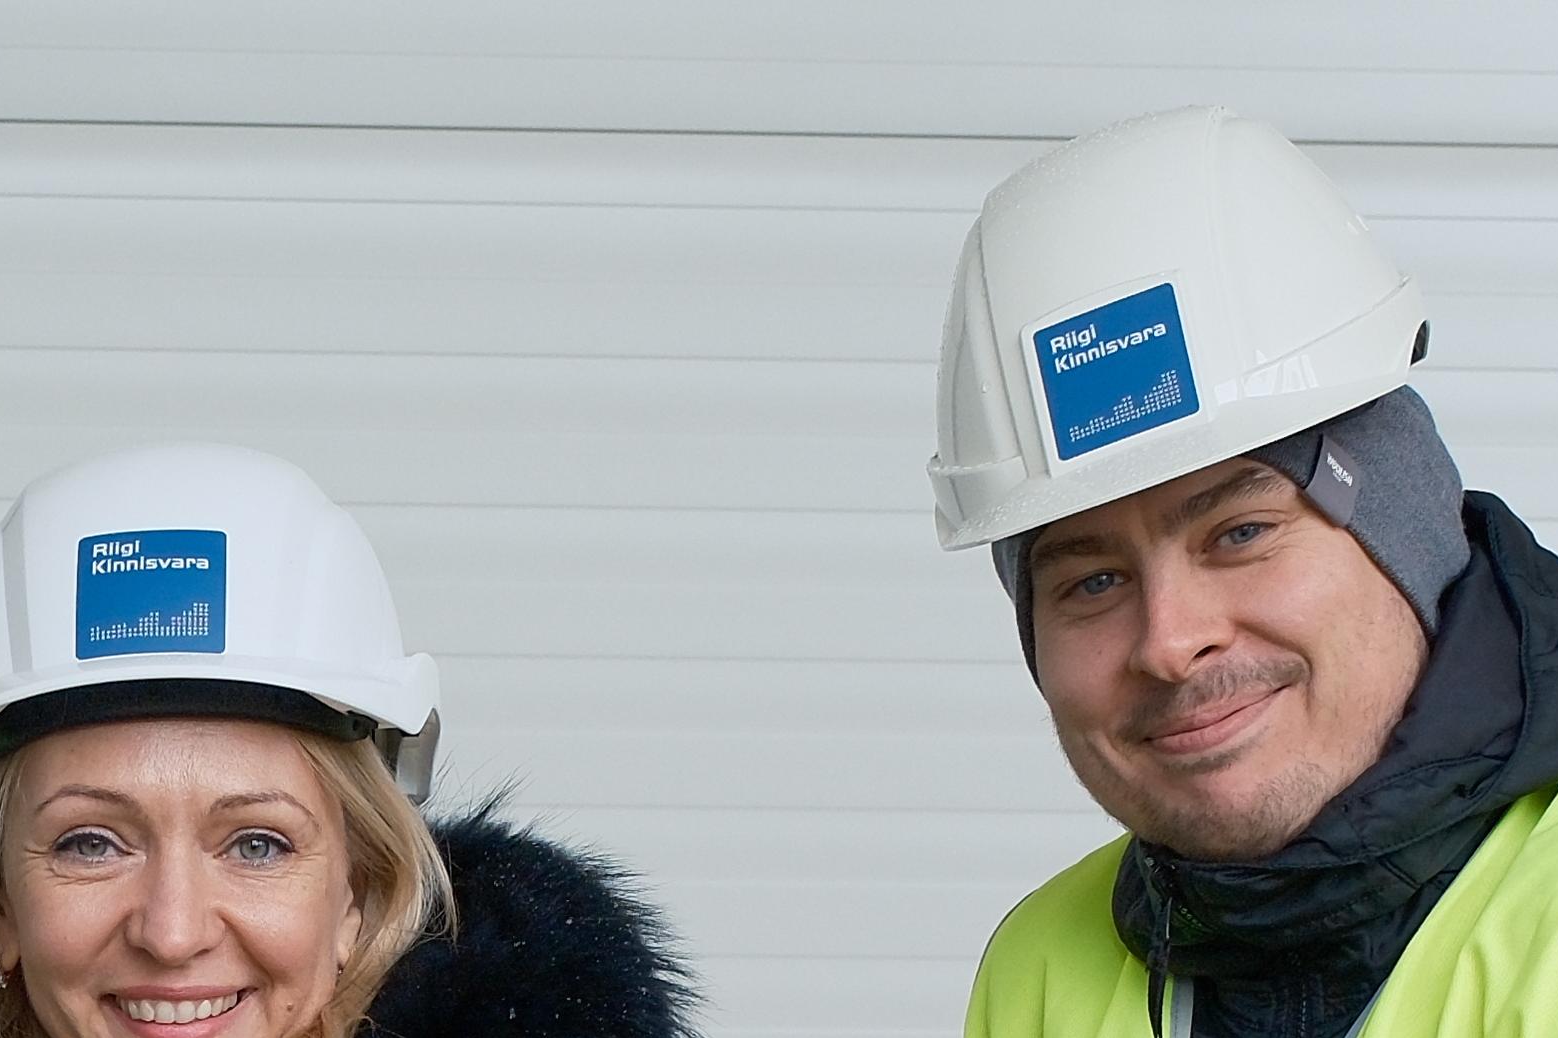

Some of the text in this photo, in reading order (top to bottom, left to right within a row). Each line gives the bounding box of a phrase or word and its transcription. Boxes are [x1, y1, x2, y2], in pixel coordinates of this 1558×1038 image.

[1049, 323, 1097, 355] Riigi
[1054, 322, 1167, 374] Kinnisvara
[92, 540, 141, 558] Riigi
[92, 556, 210, 575] Kinnisvara
